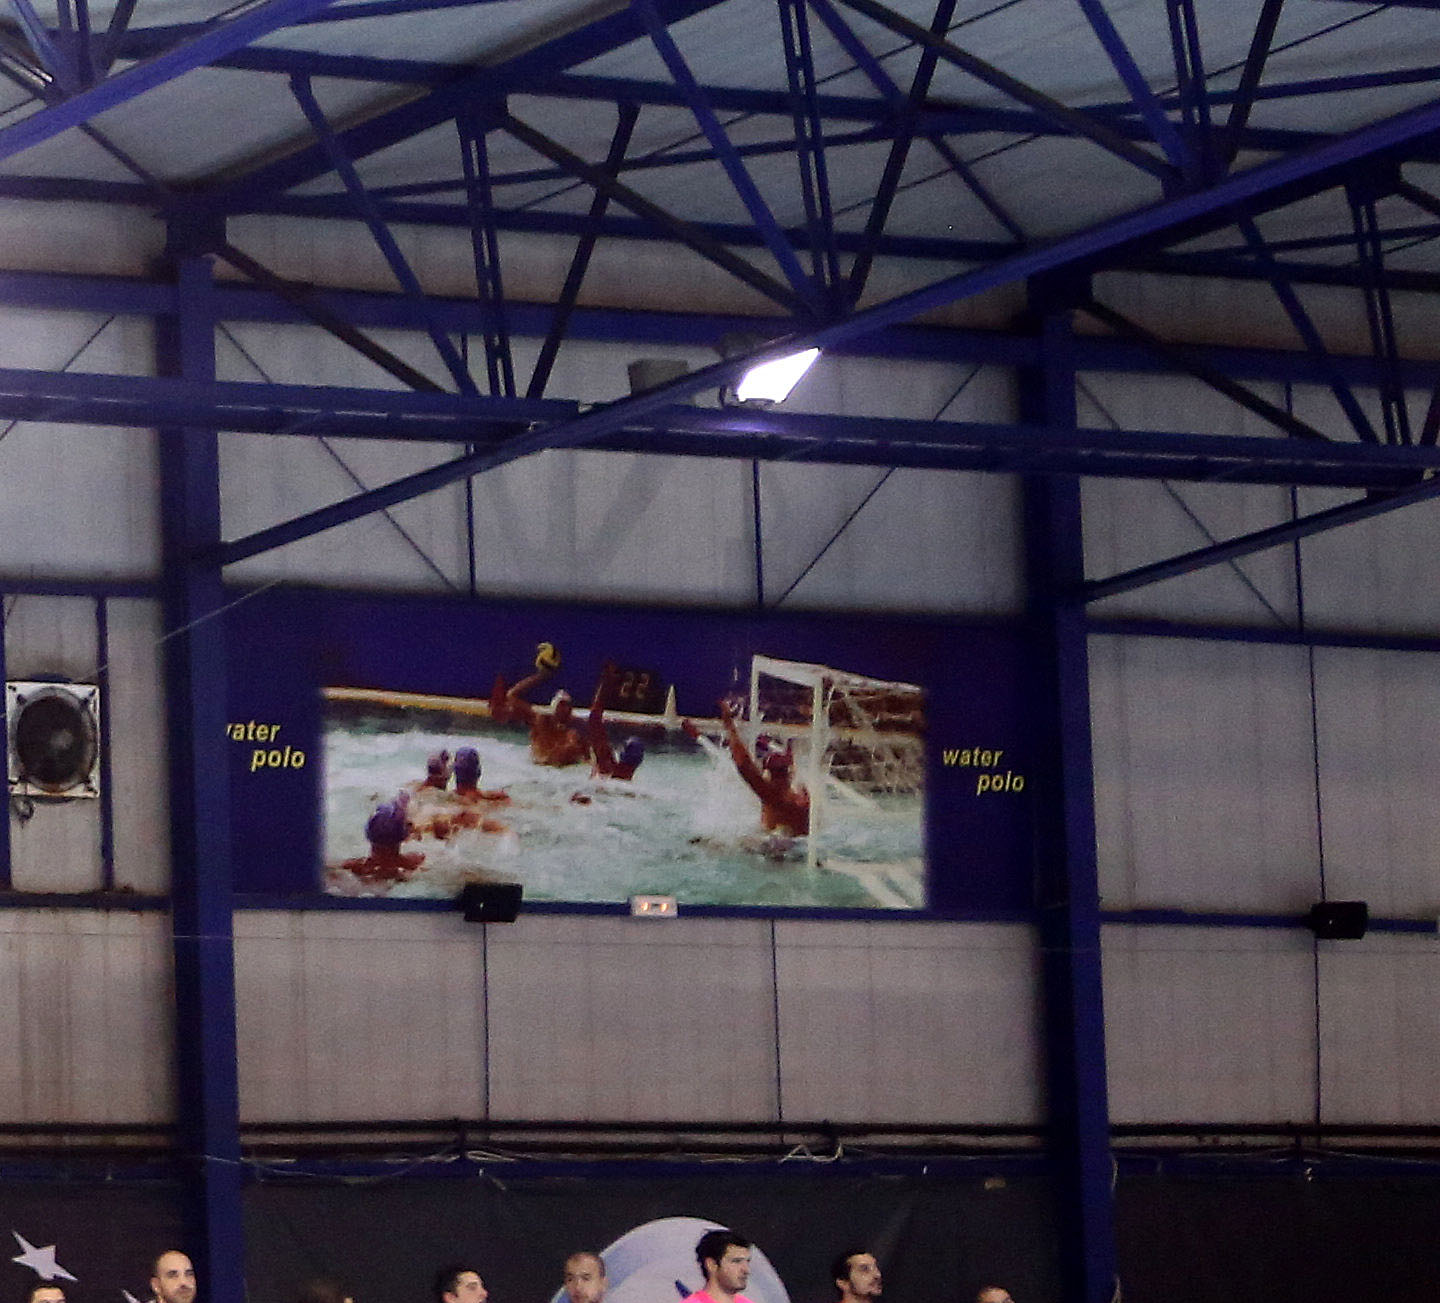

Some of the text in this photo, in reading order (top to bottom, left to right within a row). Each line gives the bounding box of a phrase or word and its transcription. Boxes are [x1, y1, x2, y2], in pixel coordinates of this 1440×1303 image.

[250, 745, 305, 772] polo
[943, 747, 1003, 767] water
[977, 770, 1024, 796] polo
